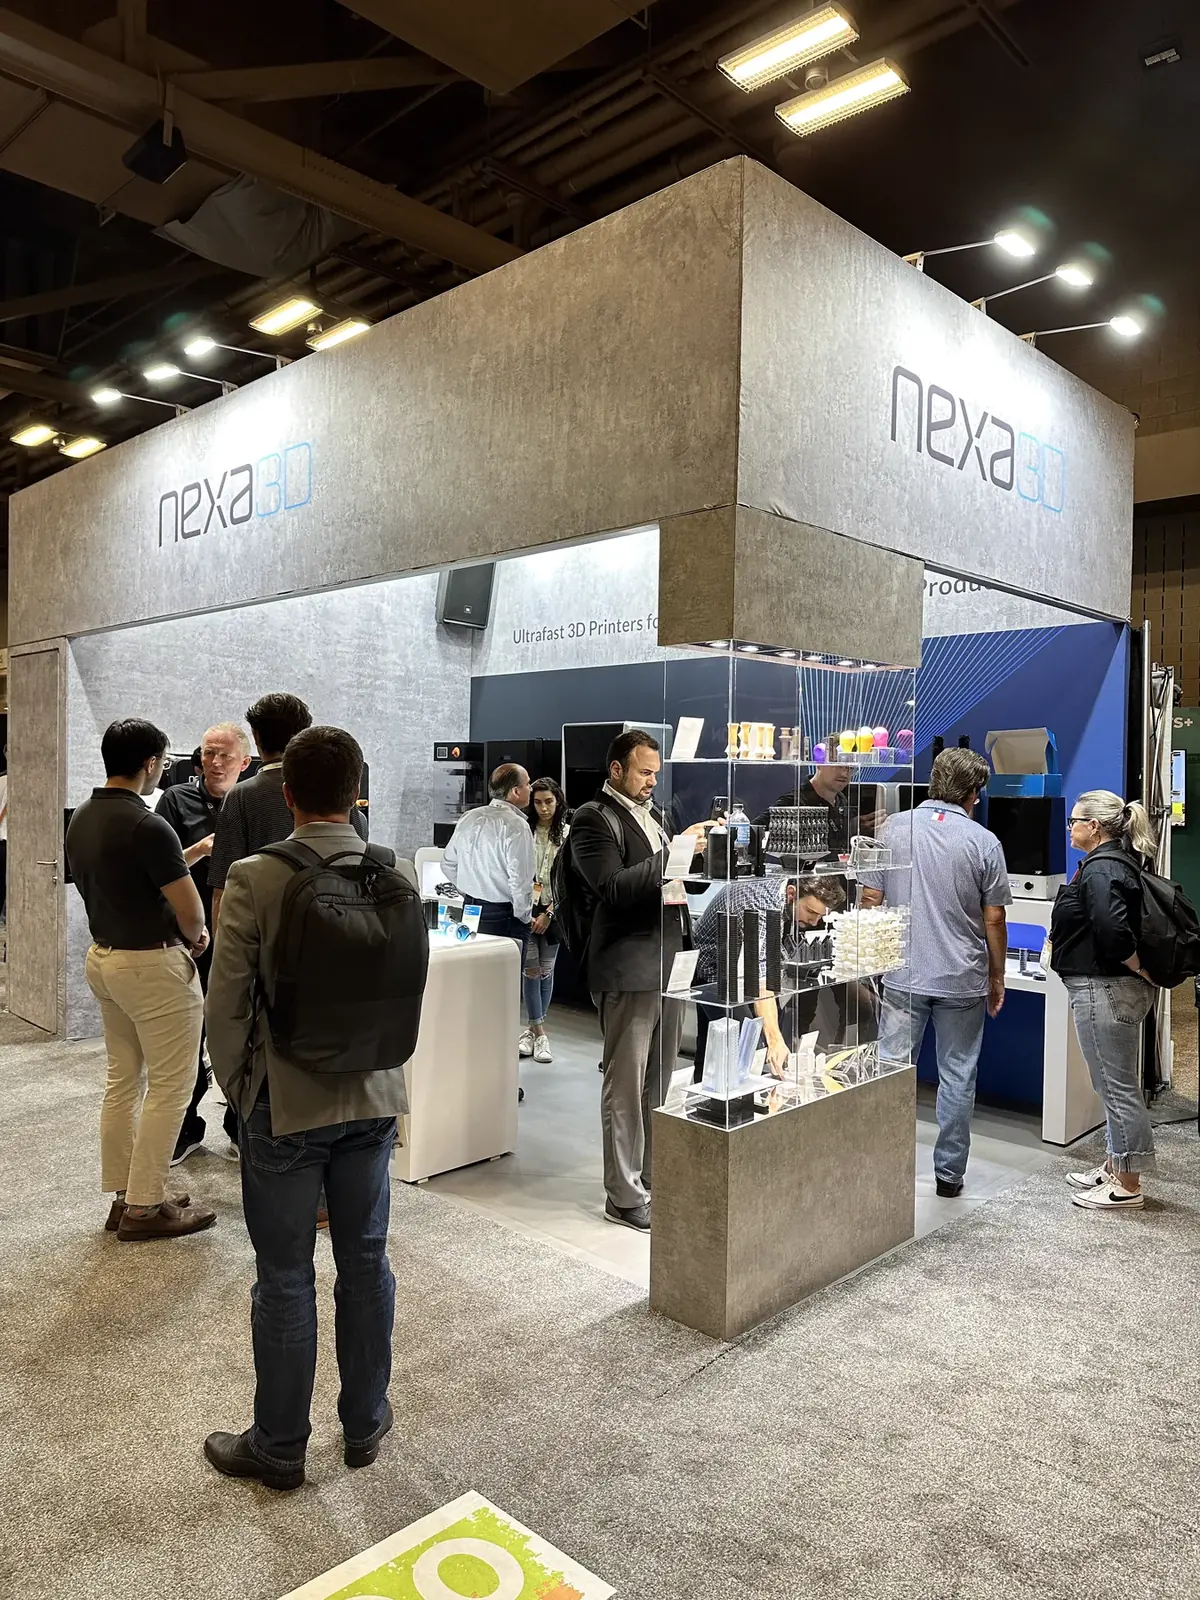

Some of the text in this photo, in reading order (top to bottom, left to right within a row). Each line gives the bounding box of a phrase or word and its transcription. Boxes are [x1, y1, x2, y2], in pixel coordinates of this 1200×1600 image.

[891, 365, 1067, 513] nexa3D
[158, 442, 313, 548] nexa3D
[920, 579, 994, 597] rodu
[513, 613, 659, 644] Ultrafast 3D Printers fo
